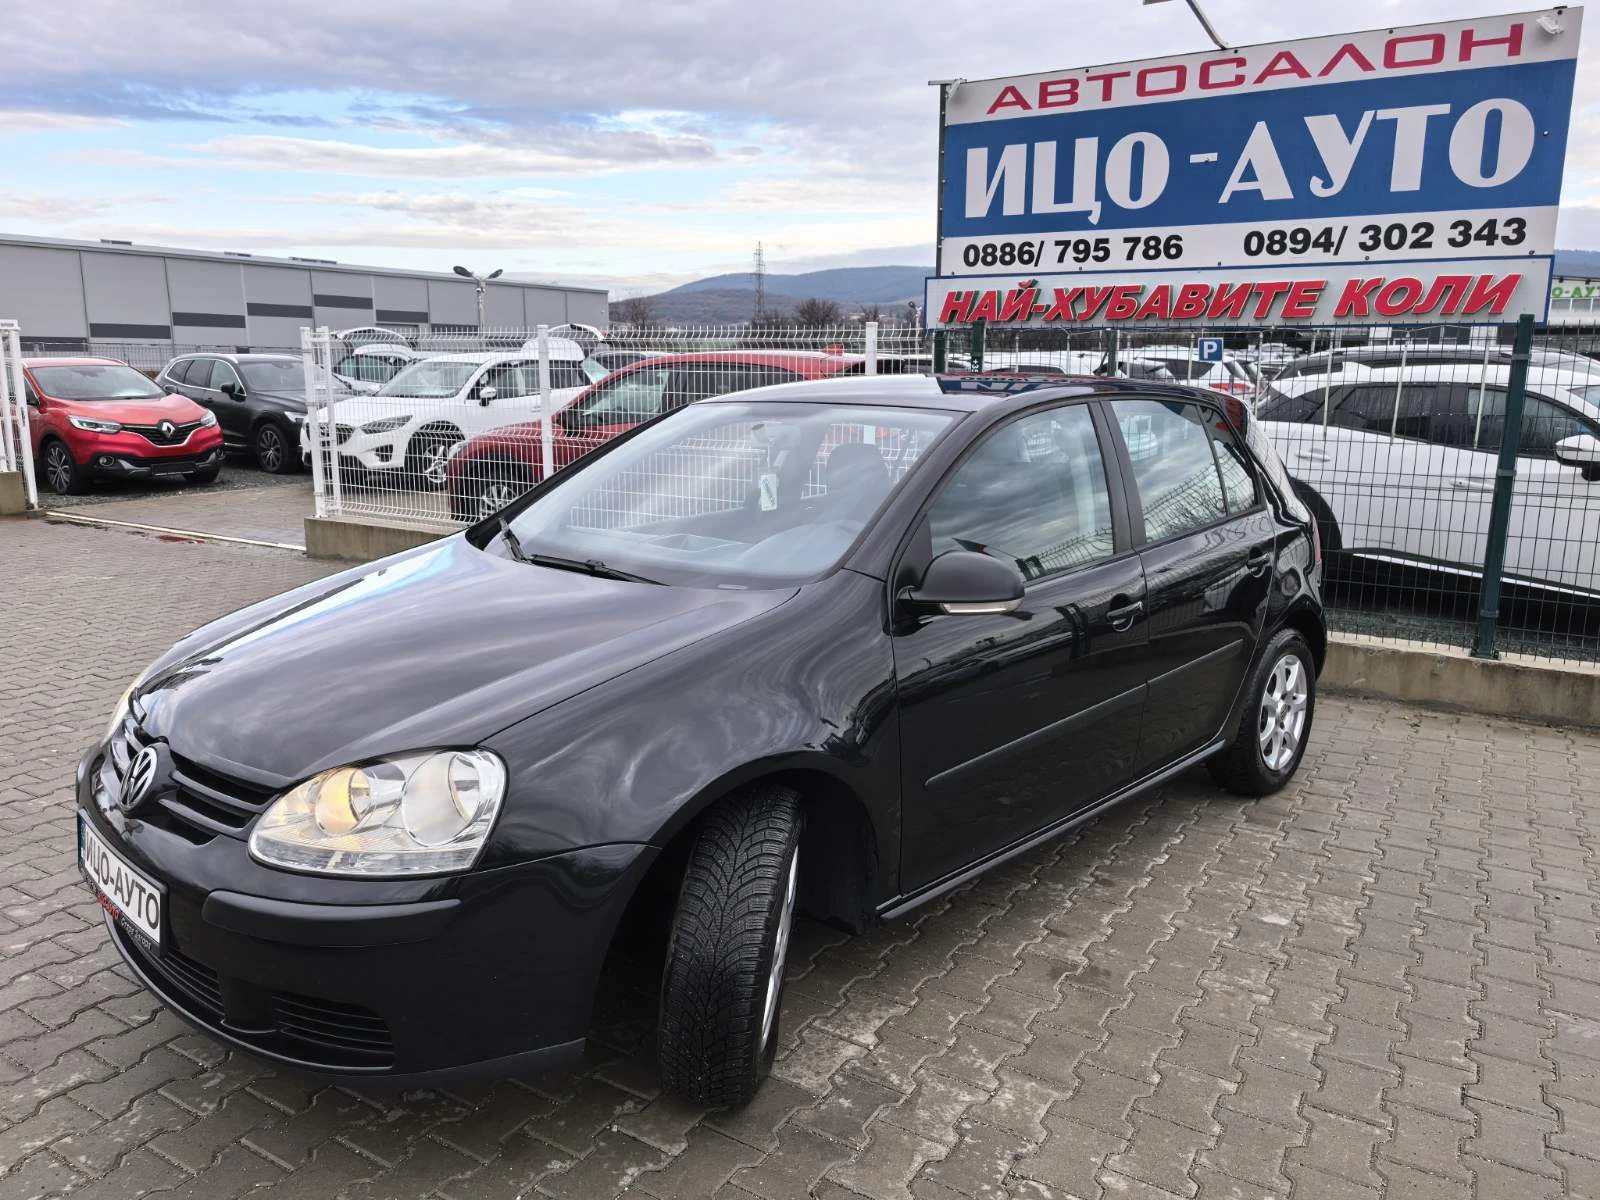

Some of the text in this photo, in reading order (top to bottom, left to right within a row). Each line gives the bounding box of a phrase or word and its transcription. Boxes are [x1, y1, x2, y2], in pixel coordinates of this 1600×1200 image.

[986, 23, 1524, 115] АВТОСАЛОН
[963, 234, 1184, 268] 0886/ 795 786
[1244, 217, 1527, 256] 0894/ 302 343
[938, 274, 1524, 323] НАЙ-ХУБАВИТЕ КОЛИ
[1552, 286, 1600, 298] О-АУ
[1203, 340, 1218, 359] P
[86, 830, 159, 930] ИЦО-АУТО
